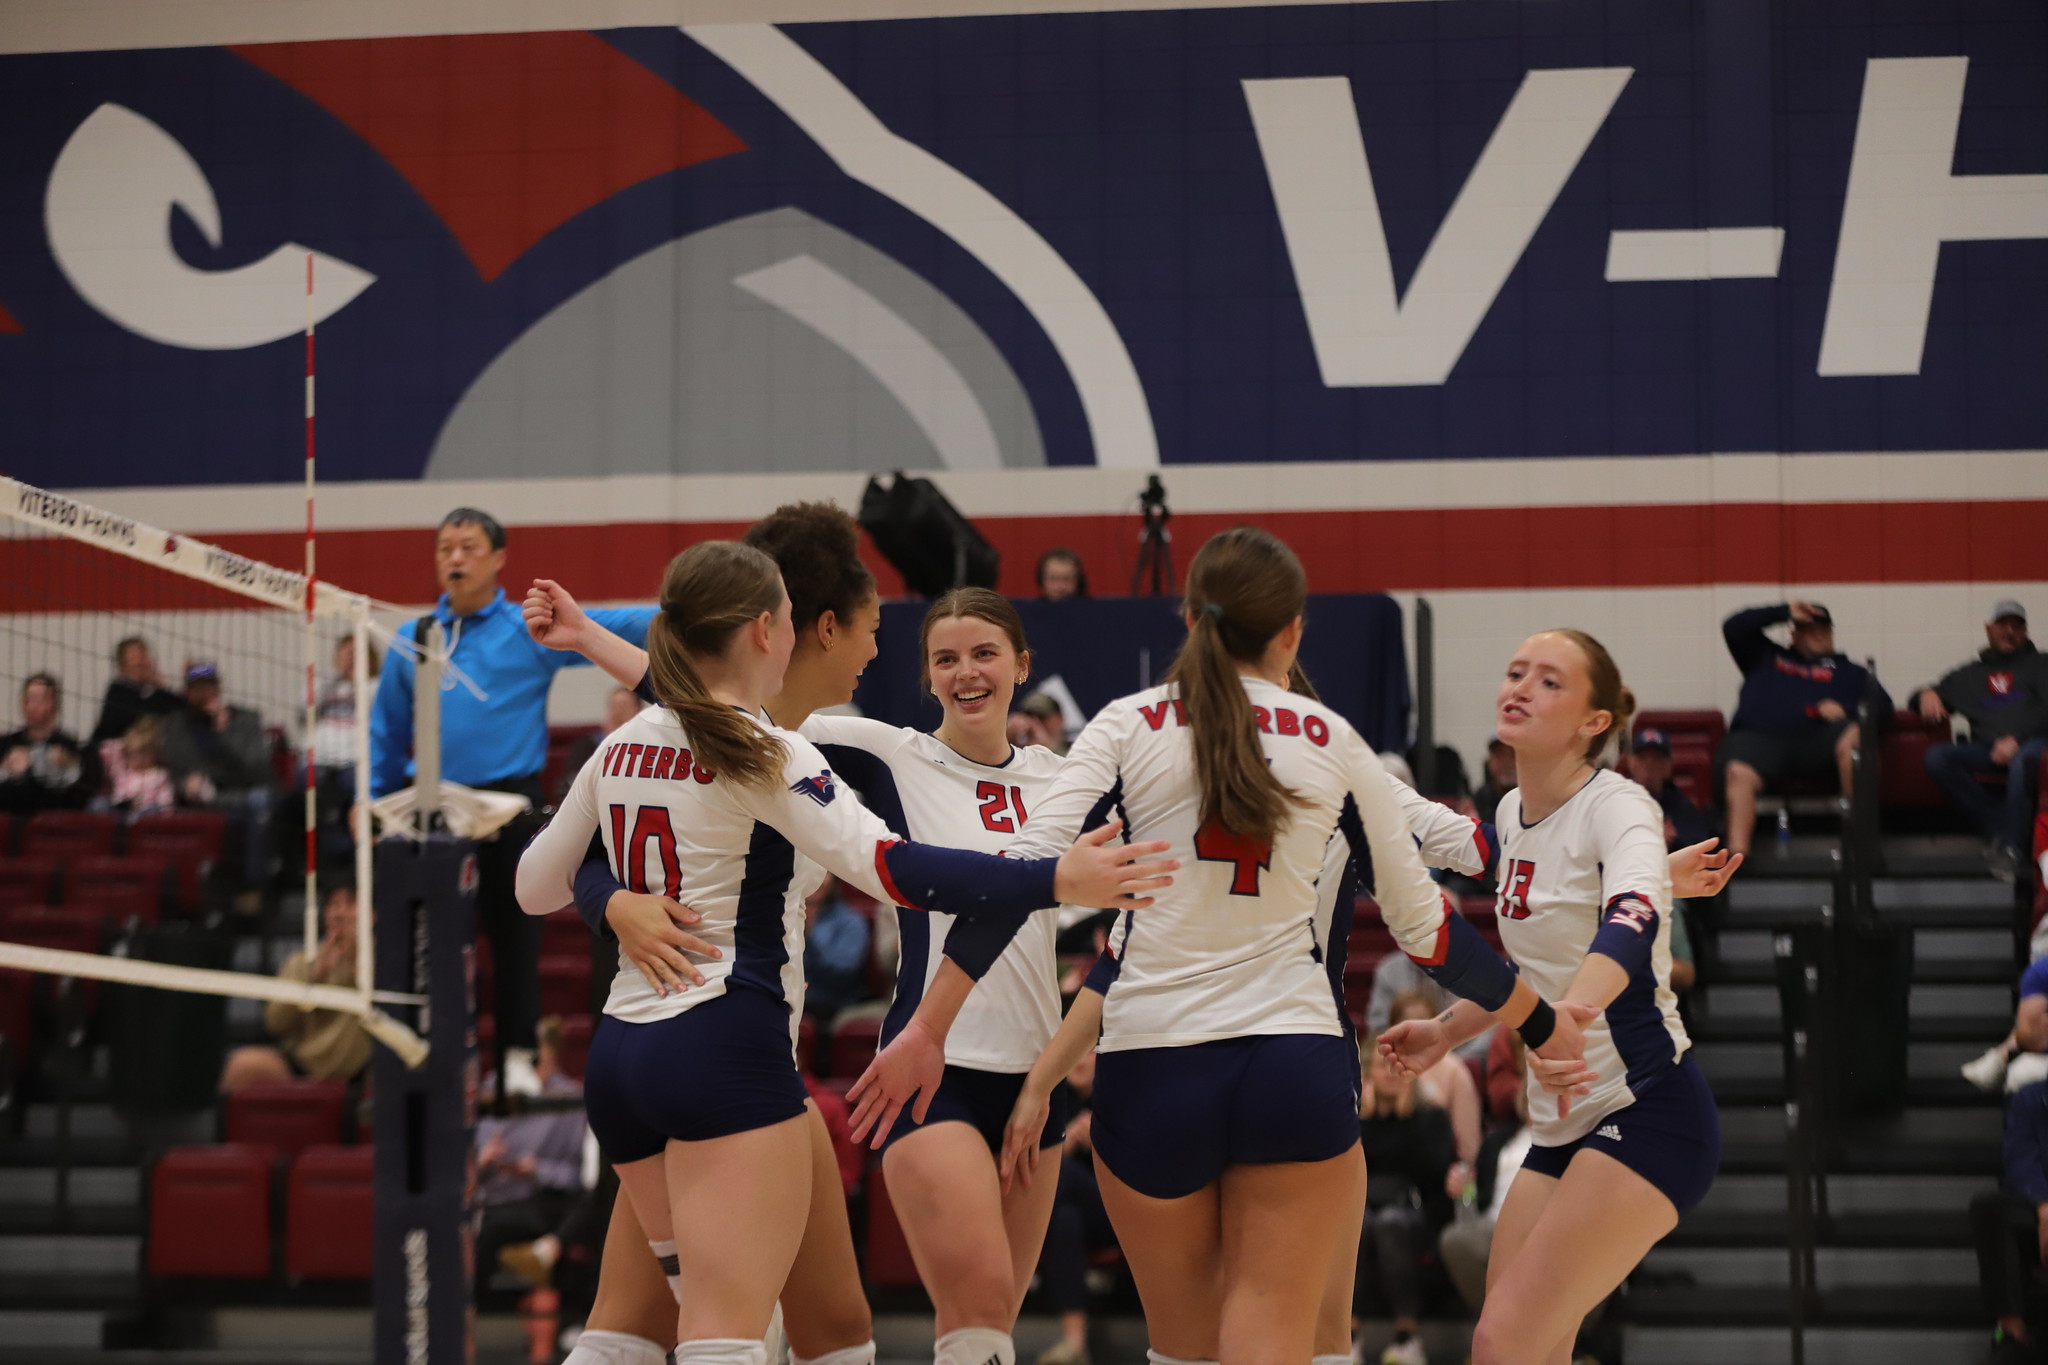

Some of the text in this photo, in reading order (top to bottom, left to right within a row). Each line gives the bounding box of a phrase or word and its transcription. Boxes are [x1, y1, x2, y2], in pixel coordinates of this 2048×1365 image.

[19, 489, 78, 527] VITERBO
[1137, 699, 1330, 748] VIRBO
[976, 780, 1028, 834] 21
[609, 804, 683, 900] 10
[1501, 858, 1536, 920] 13
